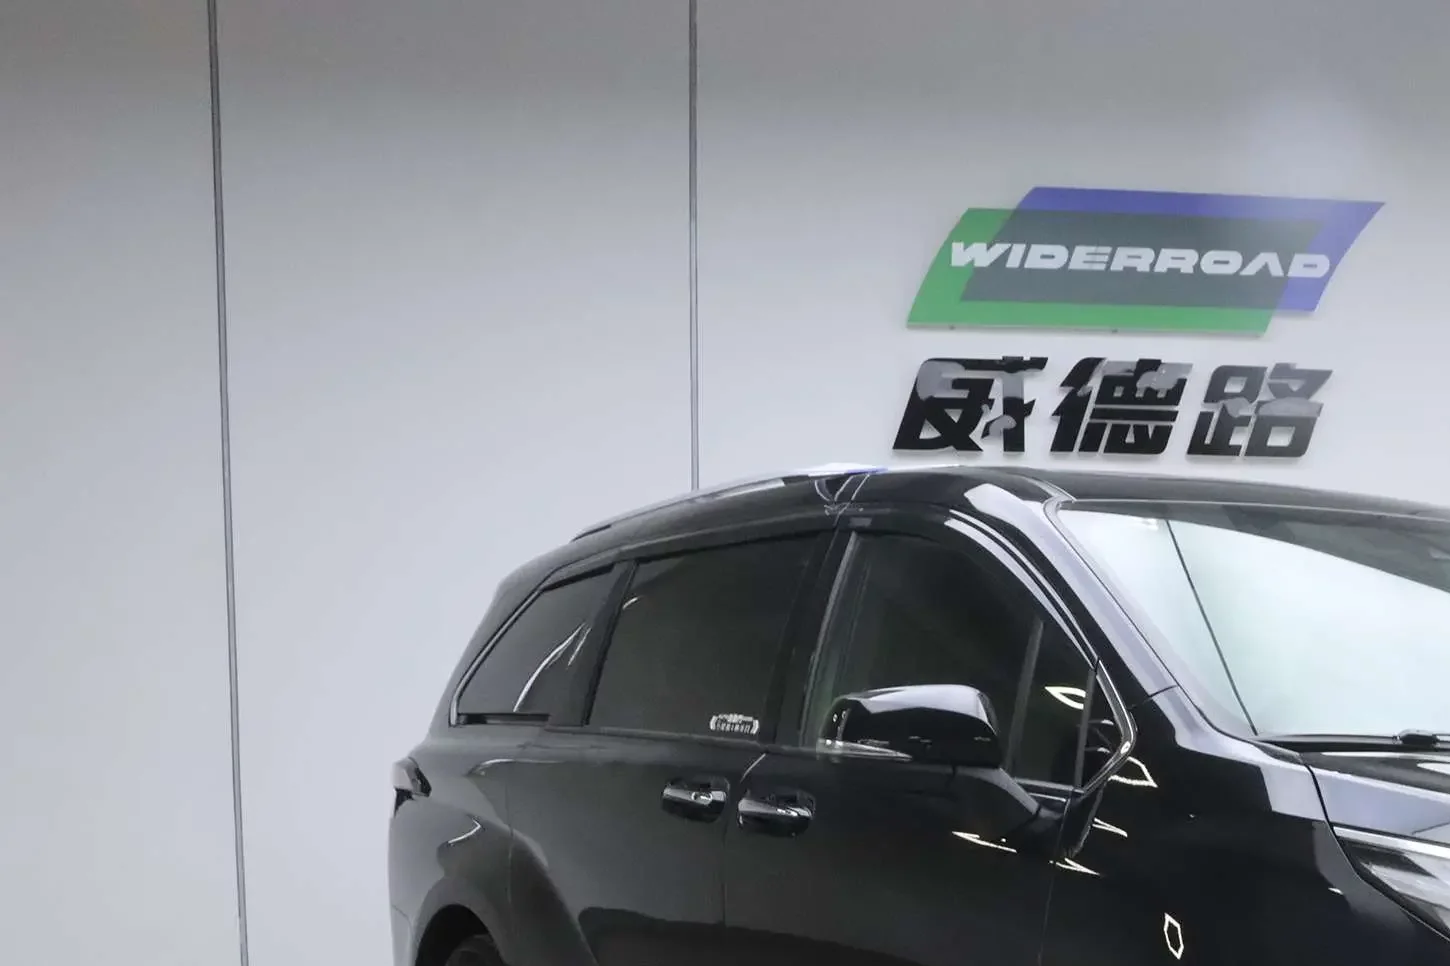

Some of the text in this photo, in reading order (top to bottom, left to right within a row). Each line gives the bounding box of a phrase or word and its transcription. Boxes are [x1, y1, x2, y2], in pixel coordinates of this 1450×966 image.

[951, 241, 1331, 278] WIDERROAD
[893, 356, 1333, 458] 威德路
